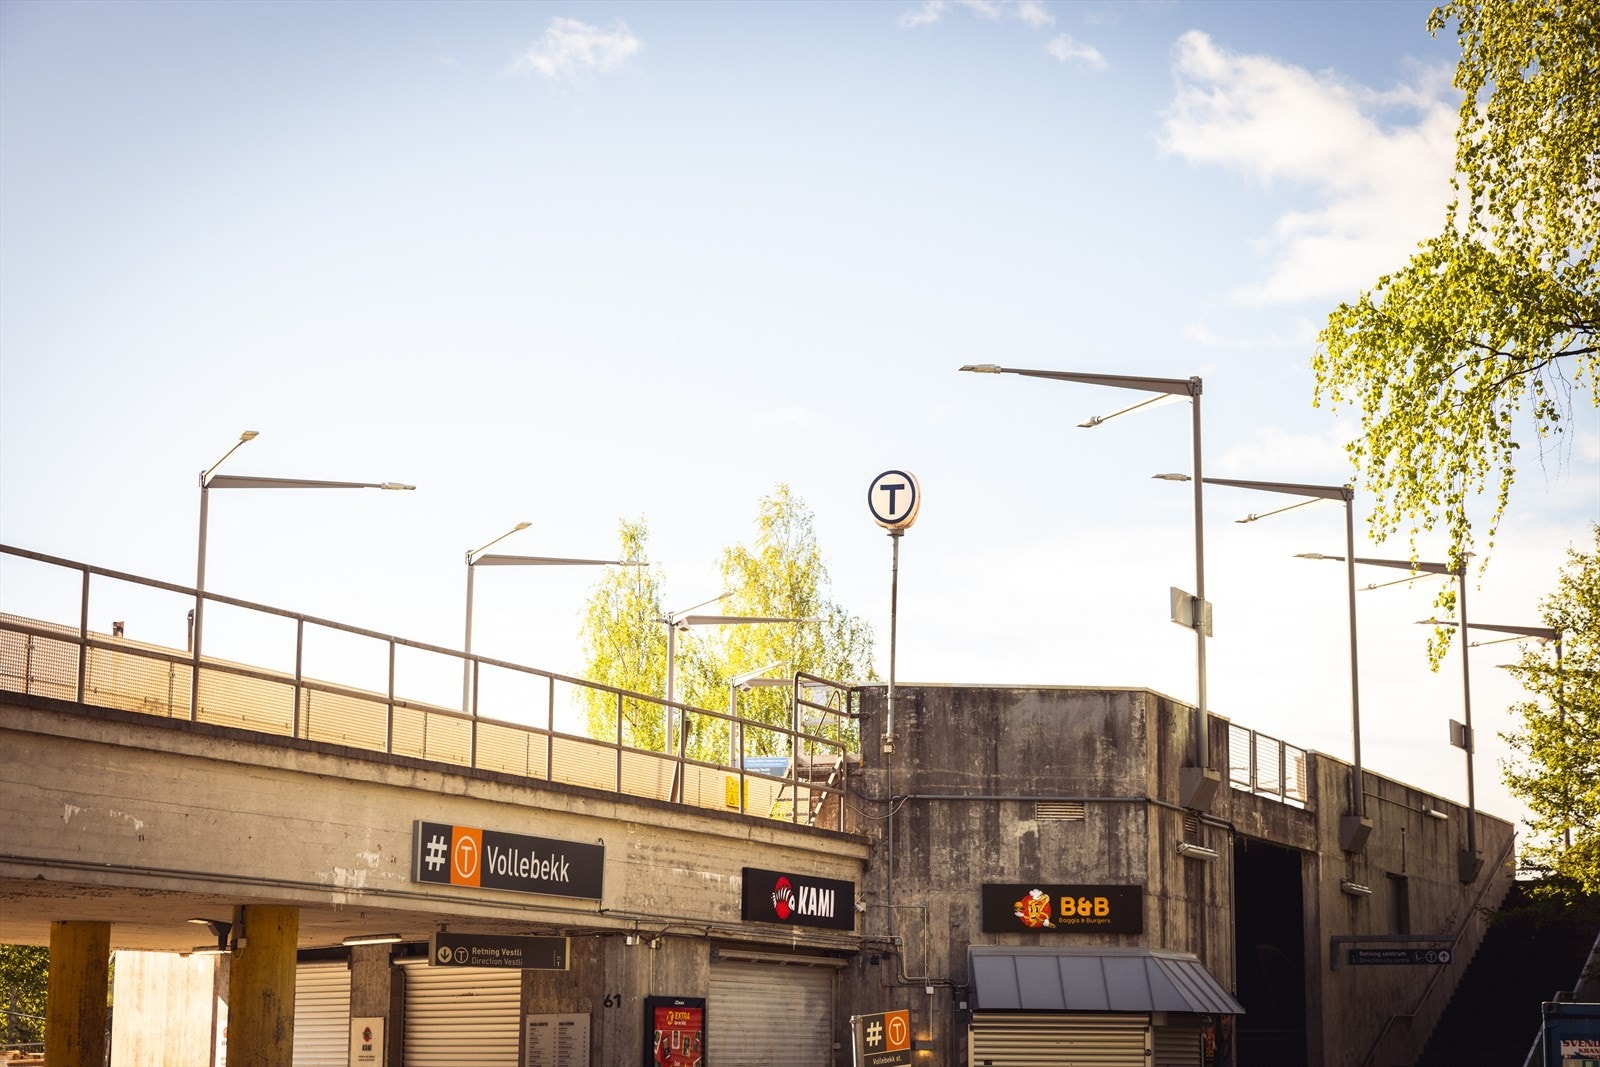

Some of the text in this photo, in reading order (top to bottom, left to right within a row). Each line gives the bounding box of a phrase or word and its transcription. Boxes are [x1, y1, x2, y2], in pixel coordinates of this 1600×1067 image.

[487, 845, 570, 883] Vollebekk
[797, 886, 835, 918] KAMI
[1060, 896, 1110, 917] B&B
[1086, 917, 1111, 925] Burgers
[471, 947, 500, 958] Retning
[501, 948, 522, 957] Vestli
[471, 957, 524, 966] Direction Vestli
[603, 994, 621, 1008] 61
[674, 1012, 691, 1021] EXTRA
[872, 1055, 896, 1065] Vollebekk
